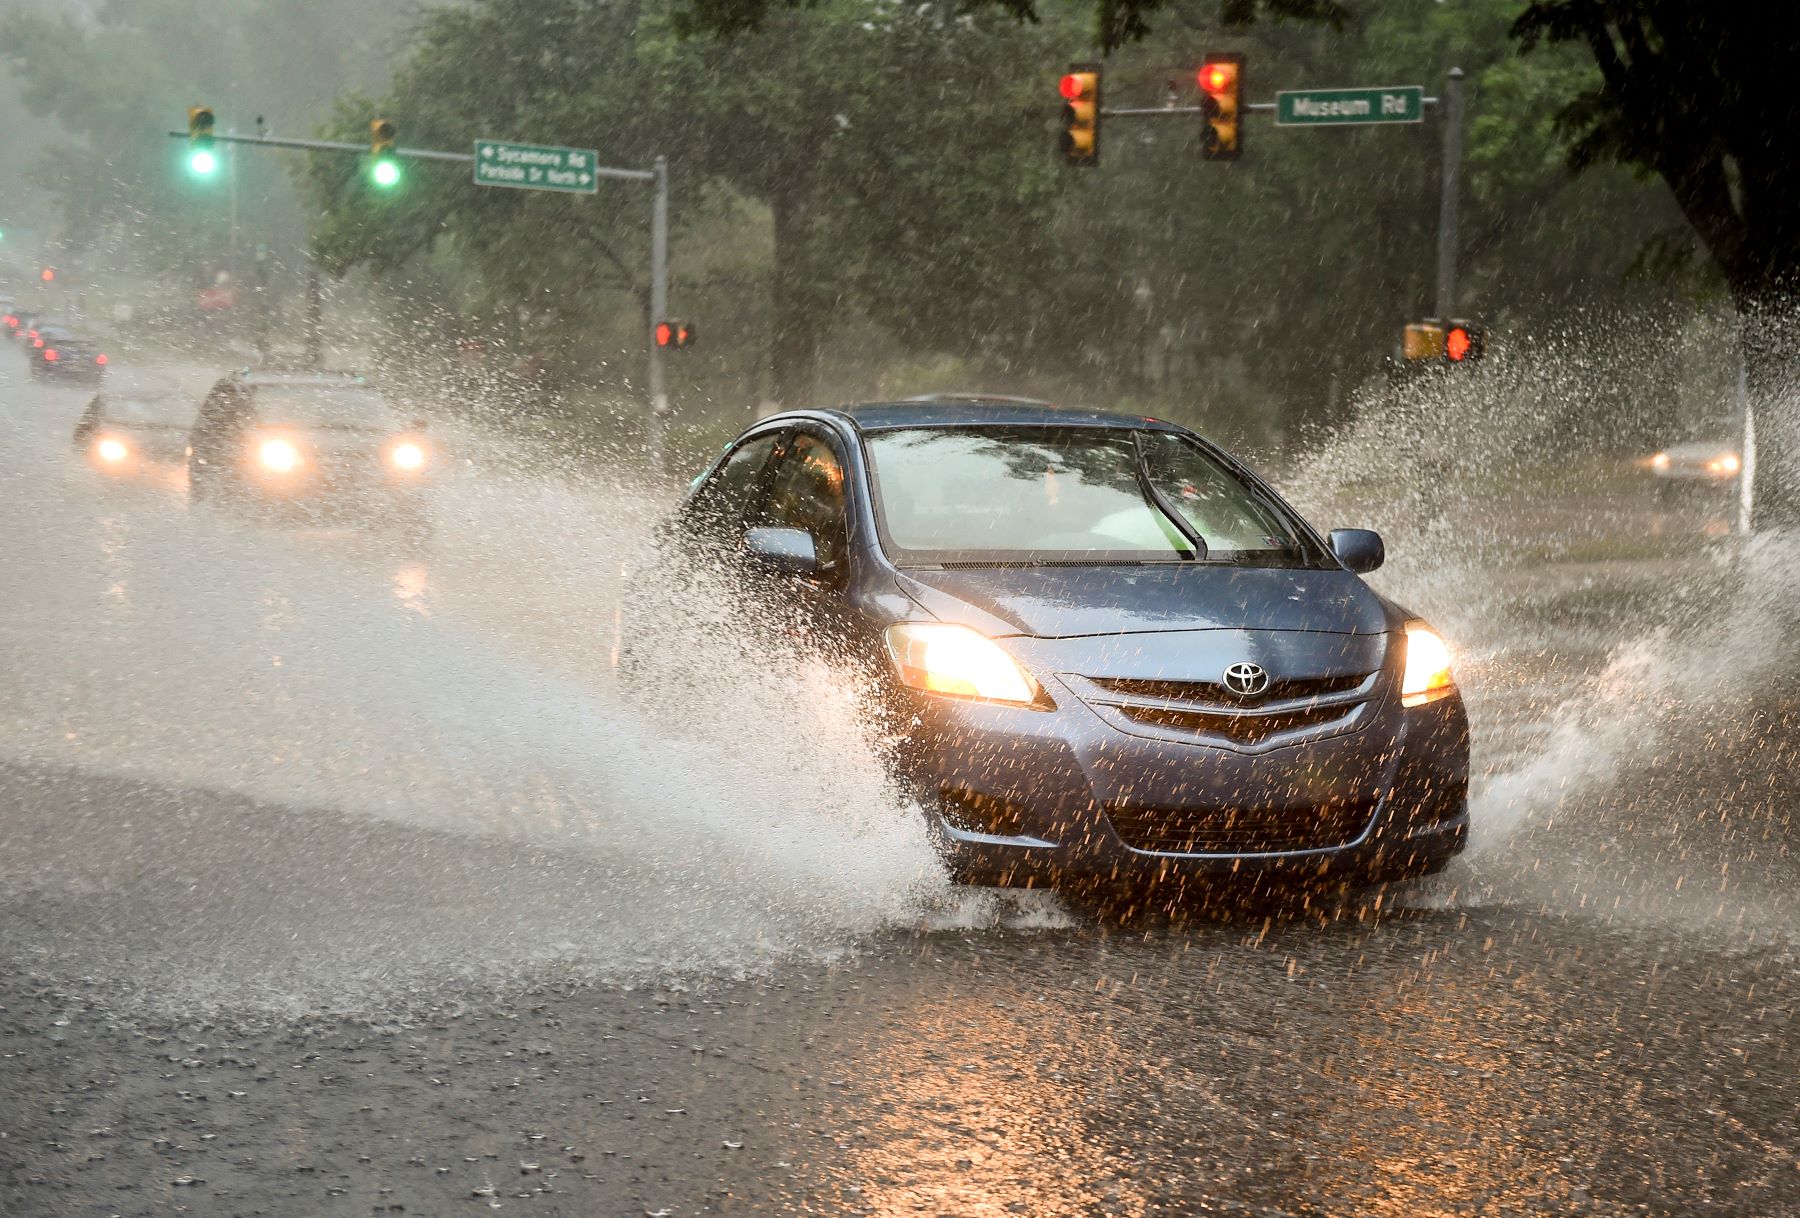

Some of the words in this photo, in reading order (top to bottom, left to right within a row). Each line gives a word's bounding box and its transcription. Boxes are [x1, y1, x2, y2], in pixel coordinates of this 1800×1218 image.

[1293, 98, 1370, 116] Museum
[1381, 94, 1406, 114] Rd
[498, 146, 561, 166] Sycamore
[568, 153, 586, 168] Rd
